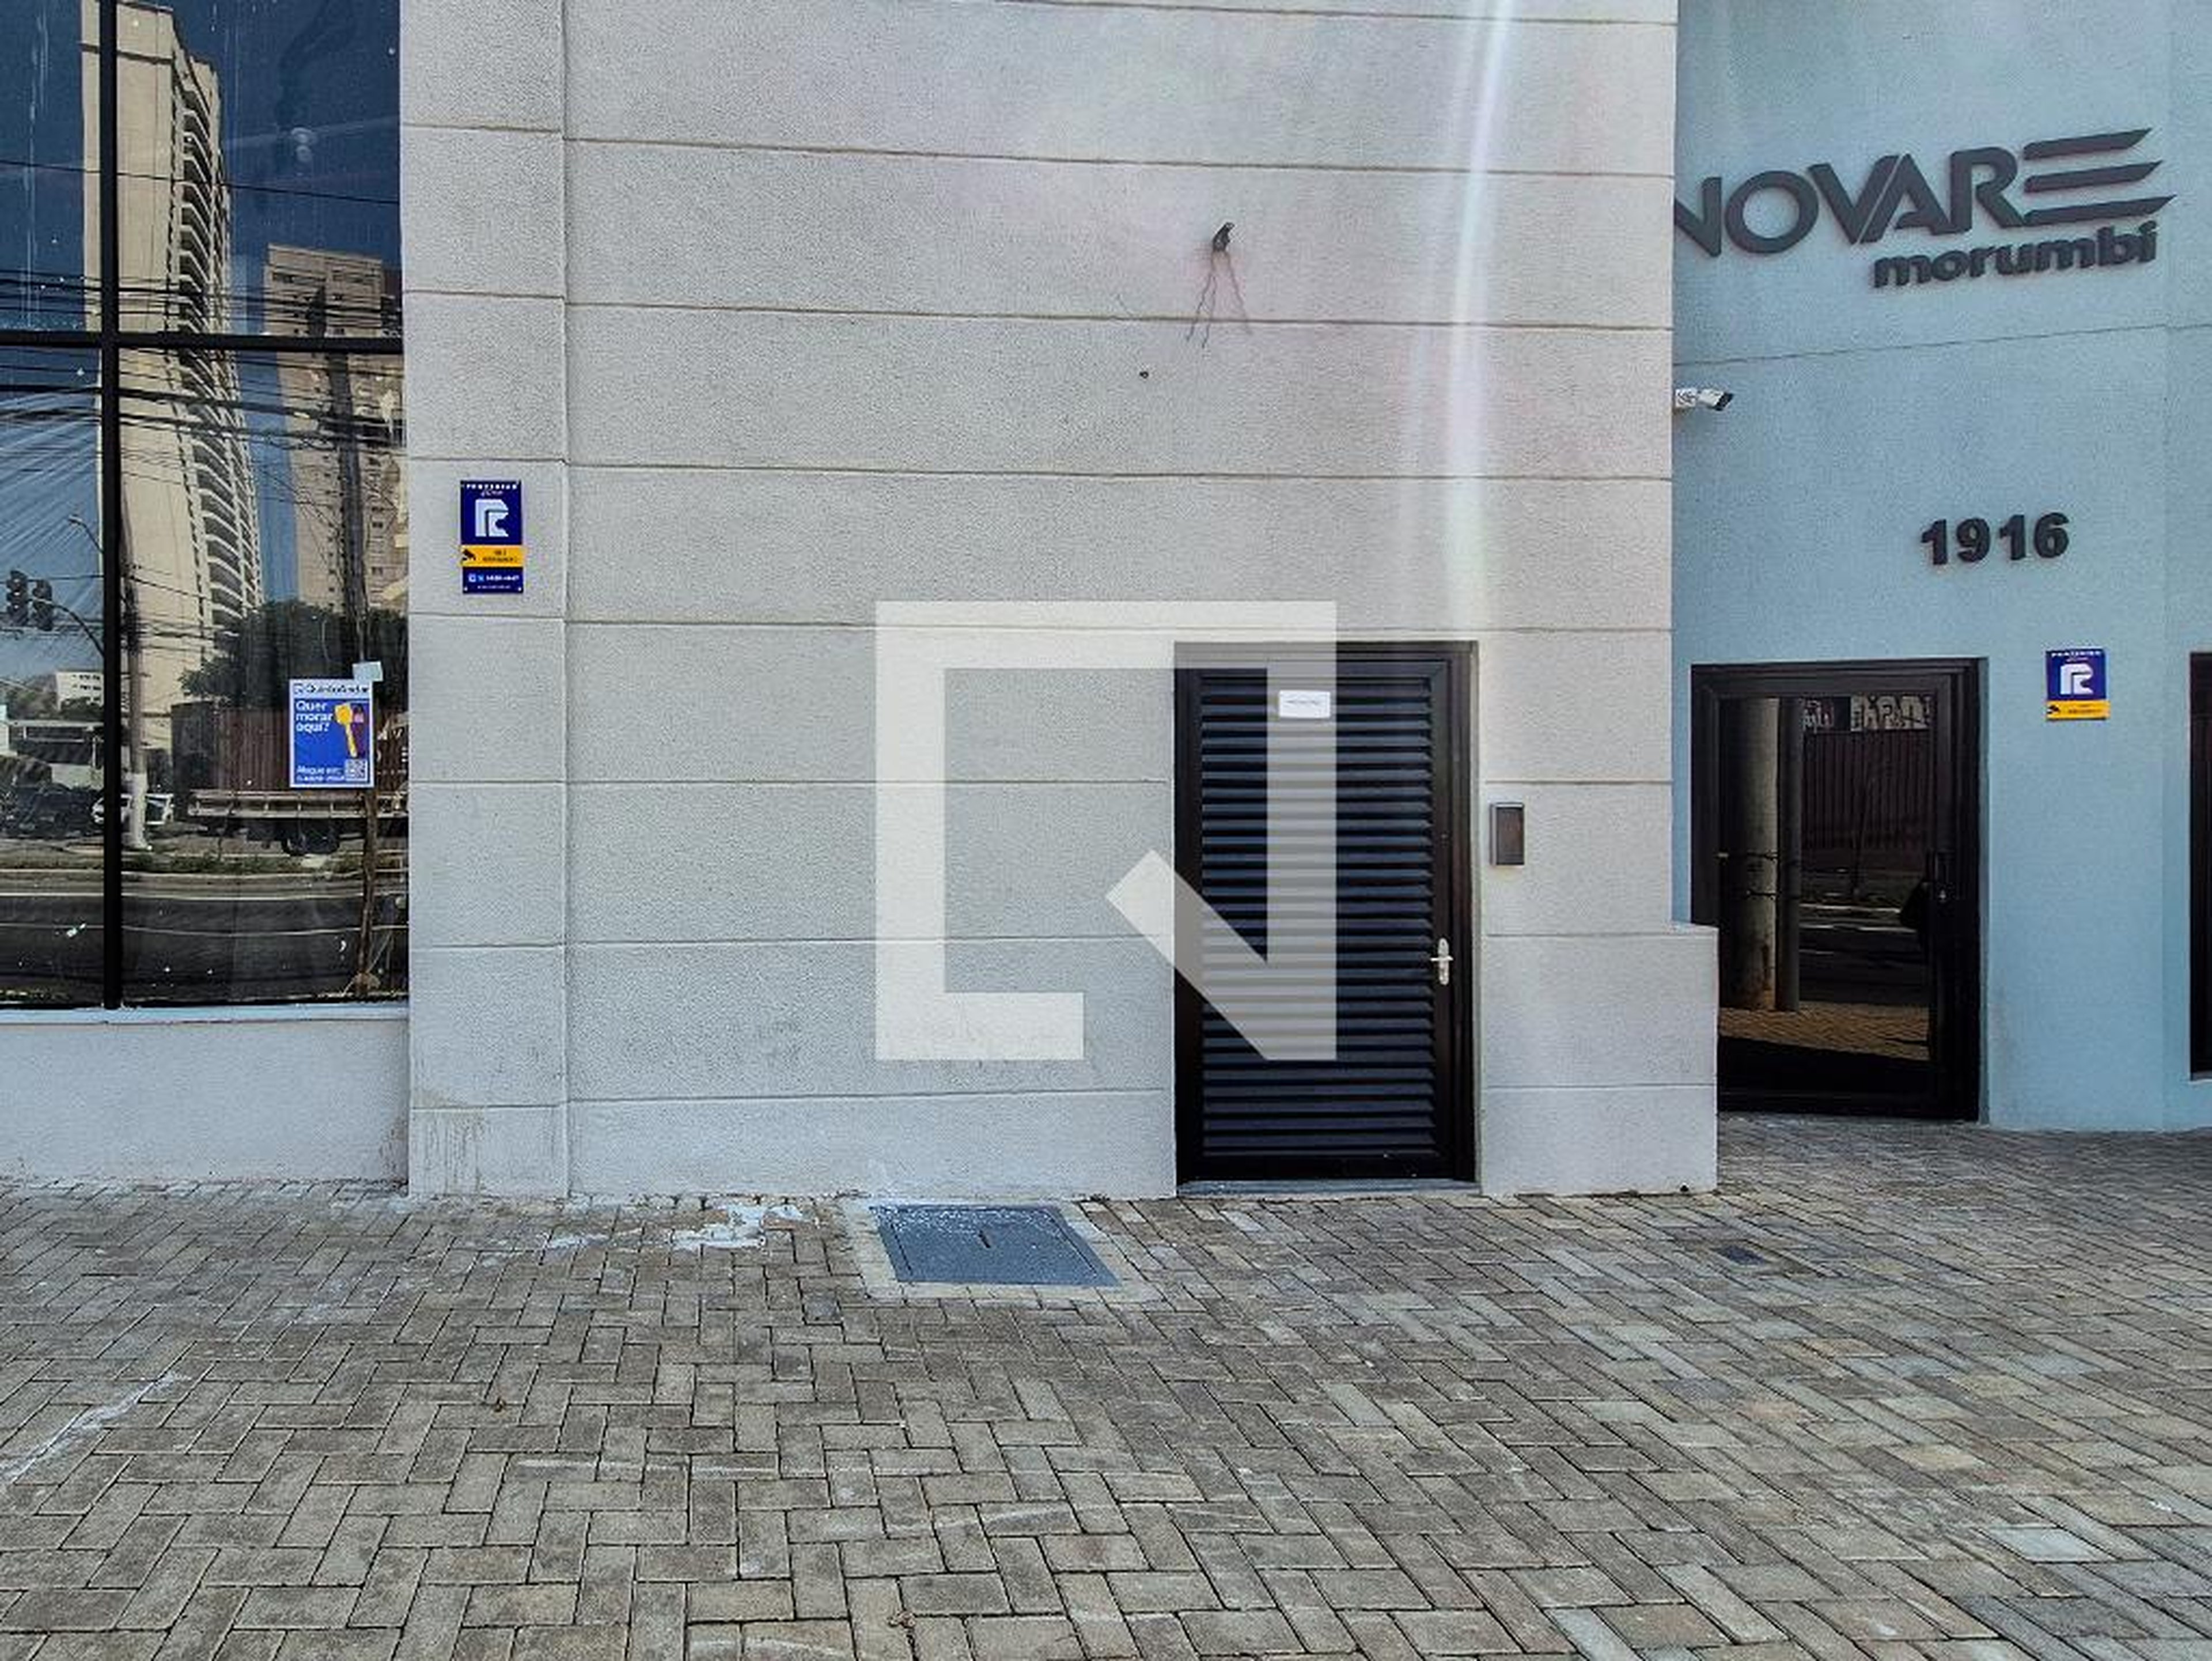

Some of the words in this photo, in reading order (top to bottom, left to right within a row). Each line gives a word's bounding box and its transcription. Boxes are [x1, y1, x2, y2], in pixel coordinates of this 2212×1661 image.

[1674, 128, 2176, 257] NOVARE
[1874, 220, 2158, 288] morumbi
[1921, 512, 2069, 565] 1916
[296, 700, 327, 712] Quer
